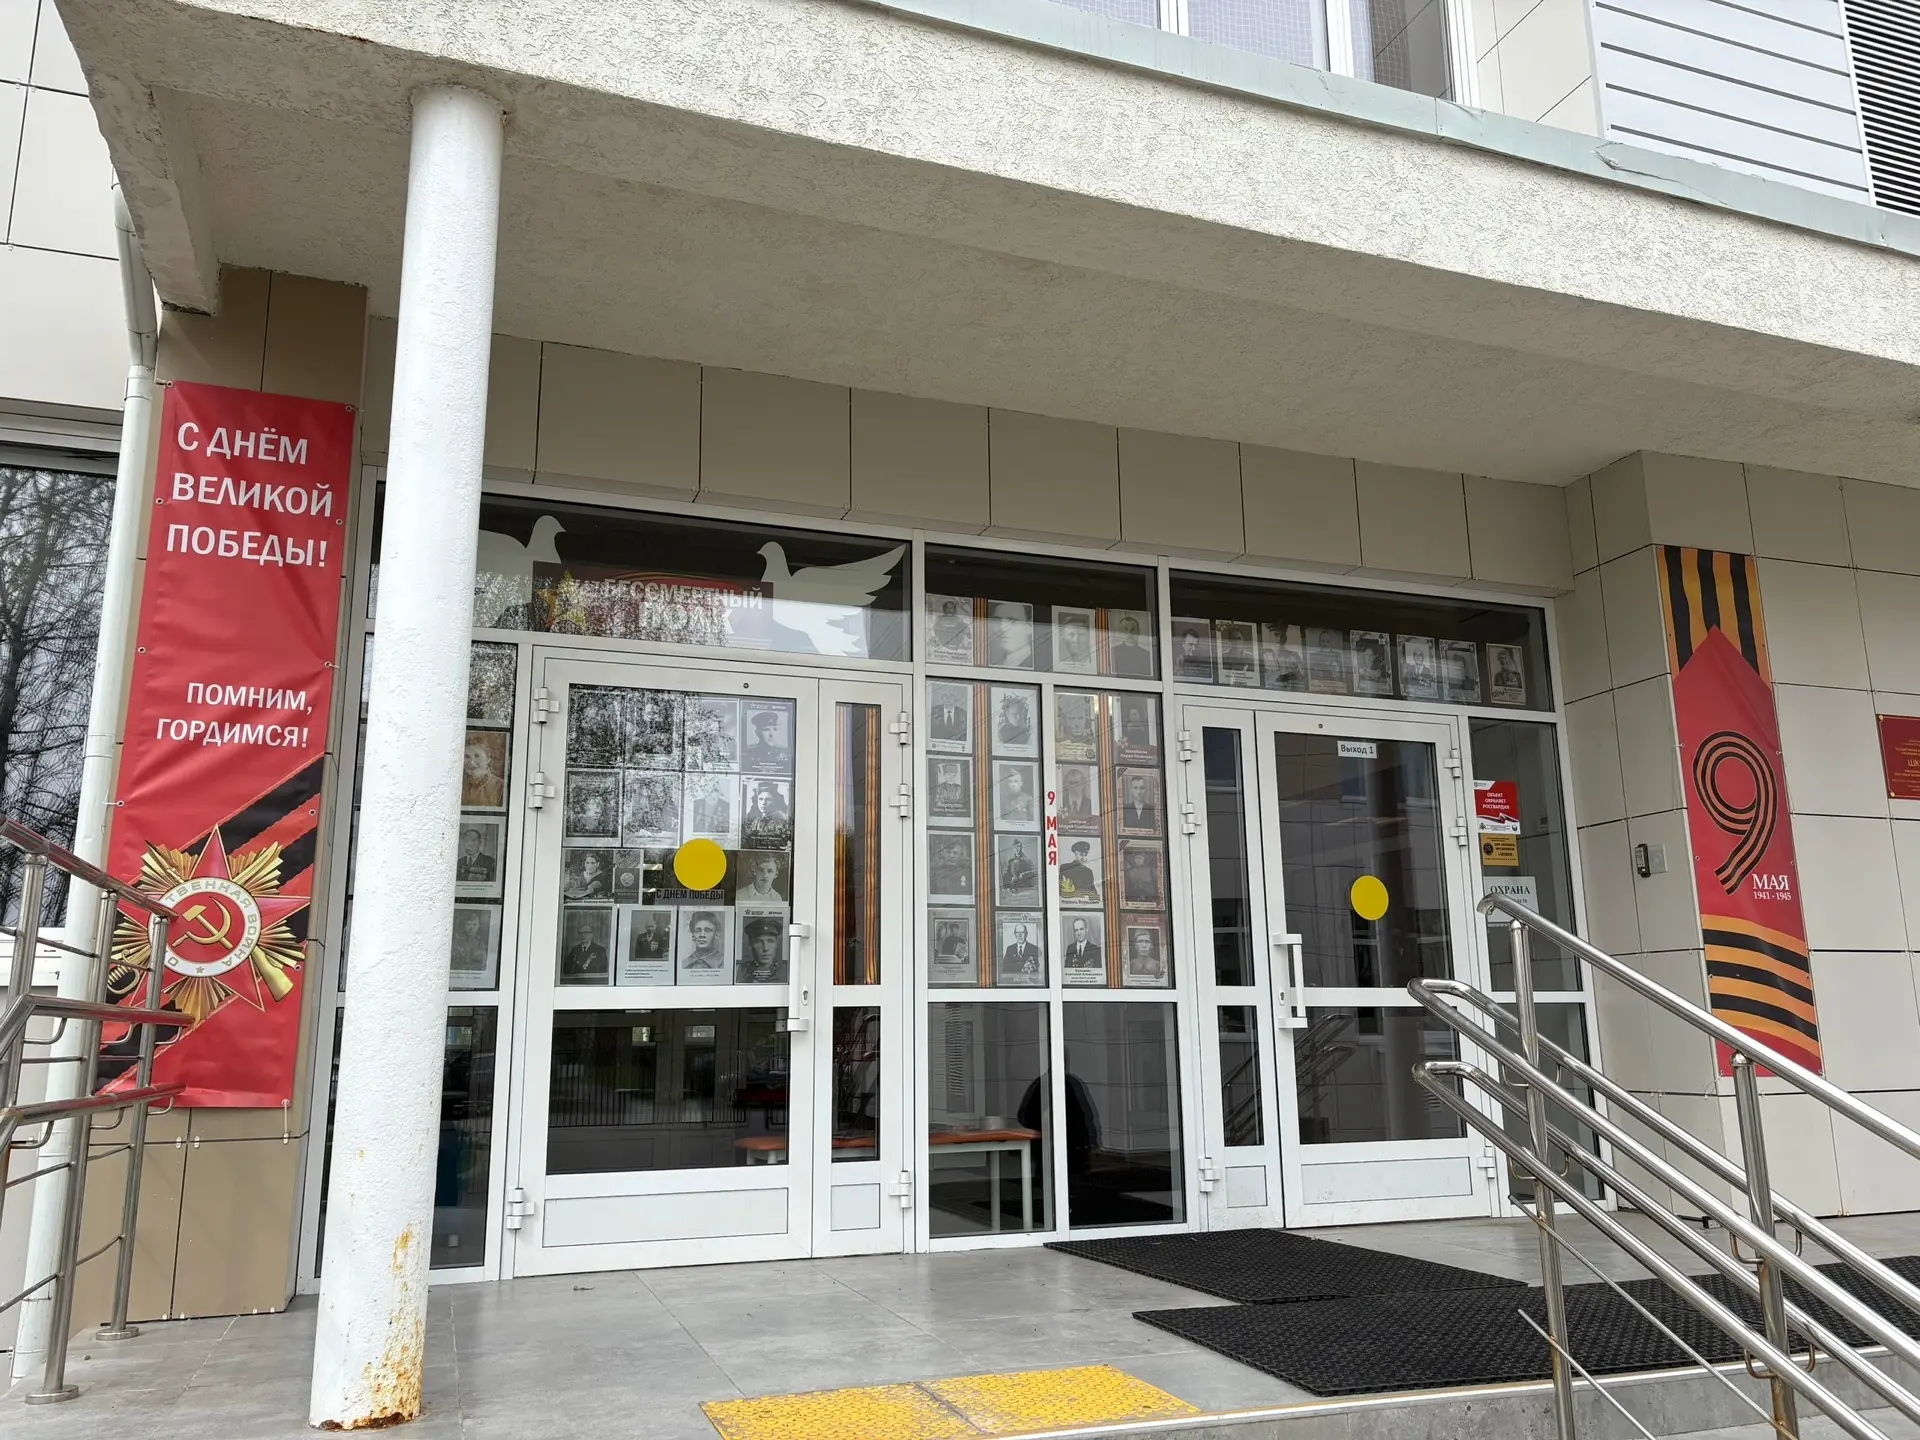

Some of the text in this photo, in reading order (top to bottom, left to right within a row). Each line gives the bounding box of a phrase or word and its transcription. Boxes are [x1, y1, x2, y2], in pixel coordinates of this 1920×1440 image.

[178, 421, 308, 465] С ДНЁМ
[172, 473, 333, 518] ВЕЛИКОЙ
[166, 524, 328, 568] ПОБЕДЫ!
[604, 578, 764, 610] БЕССМЕРТНЫЙ
[187, 682, 313, 715] ПОМНИМ,
[156, 718, 309, 748] ГОРДИМСЯ!
[1340, 744, 1374, 755] Выход 1
[1046, 791, 1057, 866] 9 МАЯ
[656, 889, 724, 901] С ДНЕМ ПОБЕДЫ
[1490, 885, 1531, 894] ОХРАНА
[1752, 873, 1790, 891] МАЯ
[1753, 891, 1770, 900] 1941
[1776, 892, 1791, 900] 1945
